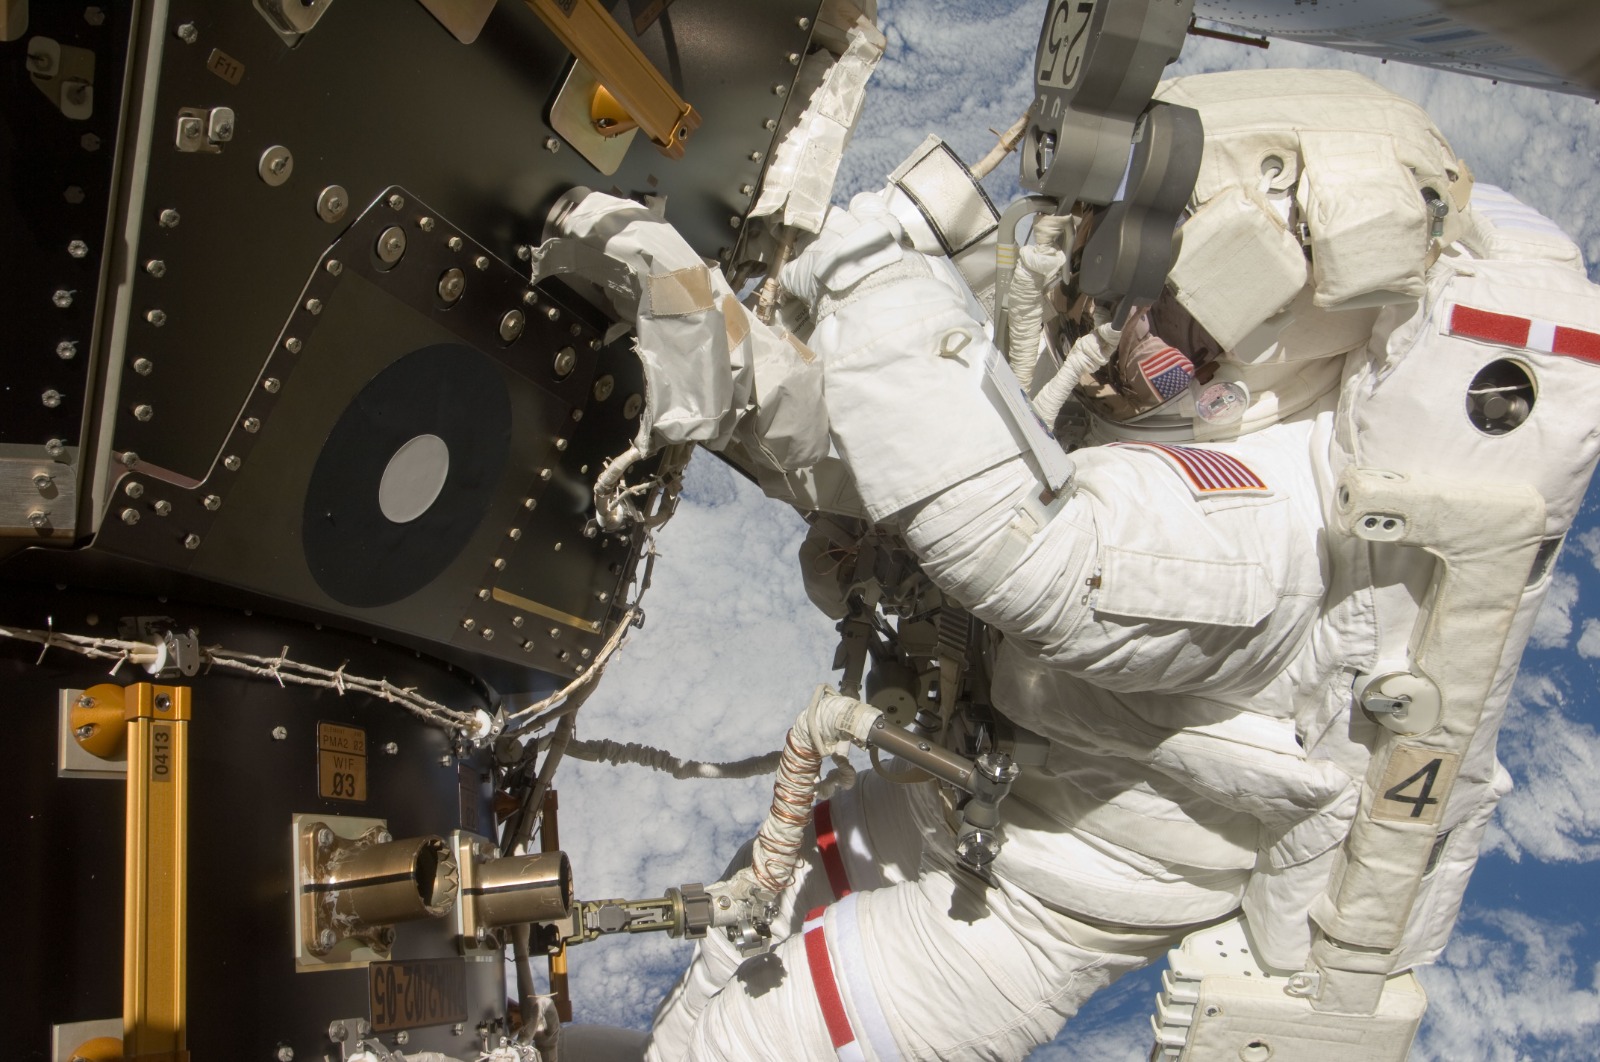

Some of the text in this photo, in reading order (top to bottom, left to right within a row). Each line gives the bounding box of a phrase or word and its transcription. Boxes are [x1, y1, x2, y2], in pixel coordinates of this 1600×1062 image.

[1041, 1, 1094, 85] 25
[214, 55, 238, 79] F11
[154, 732, 169, 775] 0413
[323, 735, 348, 748] PMA2
[333, 756, 354, 770] WIF
[1384, 758, 1442, 817] 4
